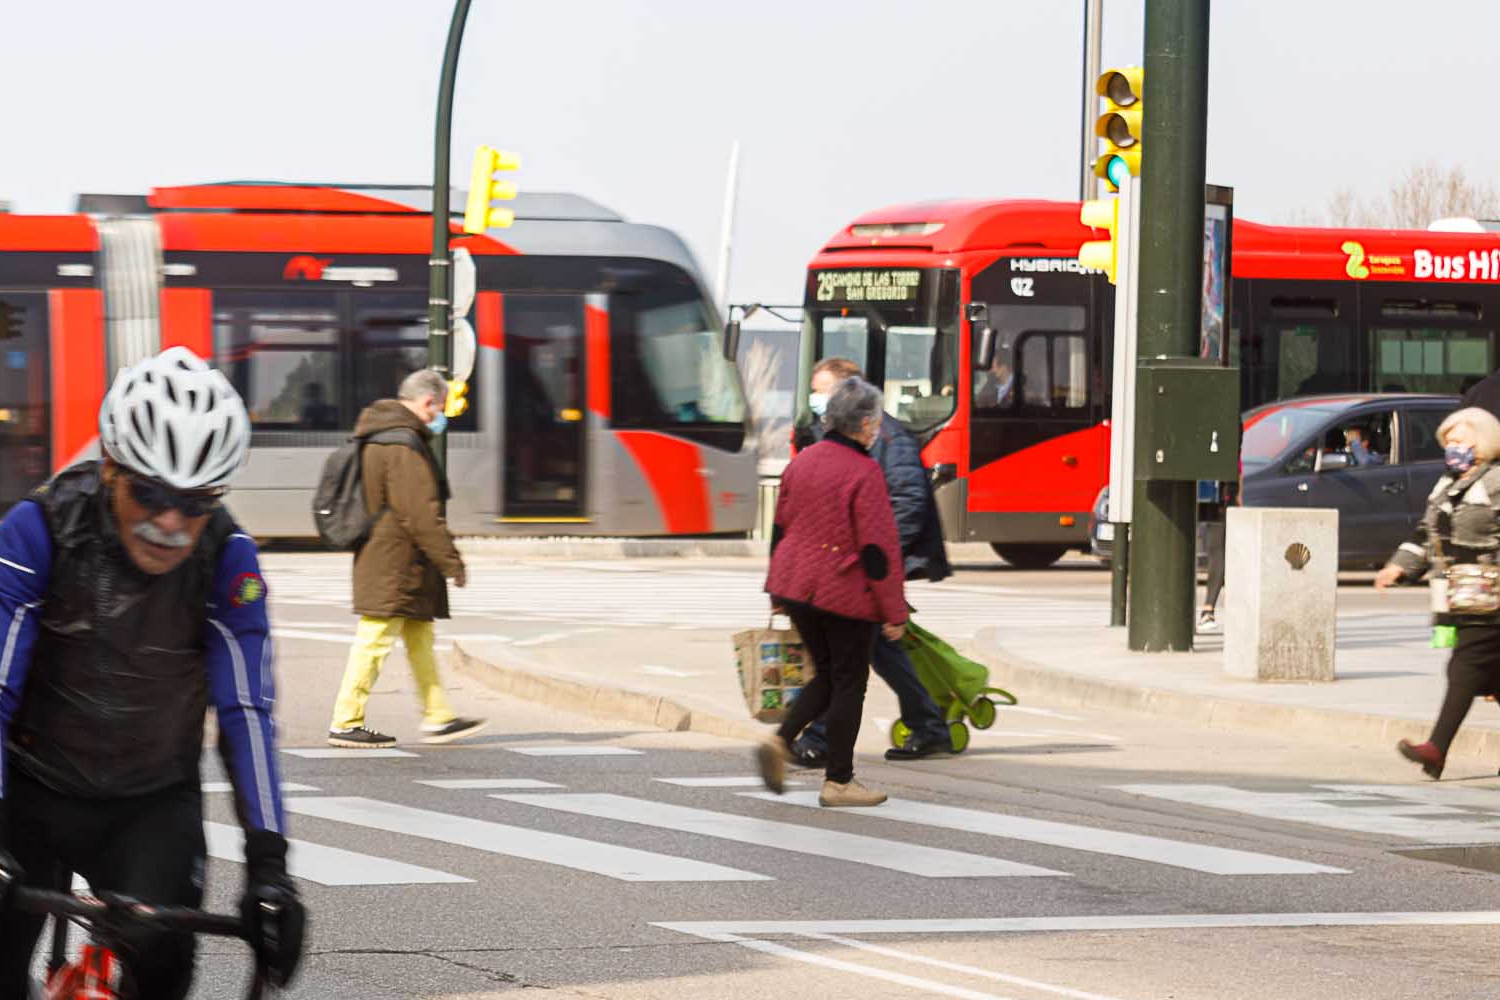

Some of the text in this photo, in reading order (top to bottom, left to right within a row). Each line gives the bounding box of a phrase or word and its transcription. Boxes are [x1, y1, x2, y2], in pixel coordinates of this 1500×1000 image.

[1414, 249, 1465, 279] Bus
[874, 271, 891, 287] LAS
[846, 286, 908, 300] SAN GREGORIO
